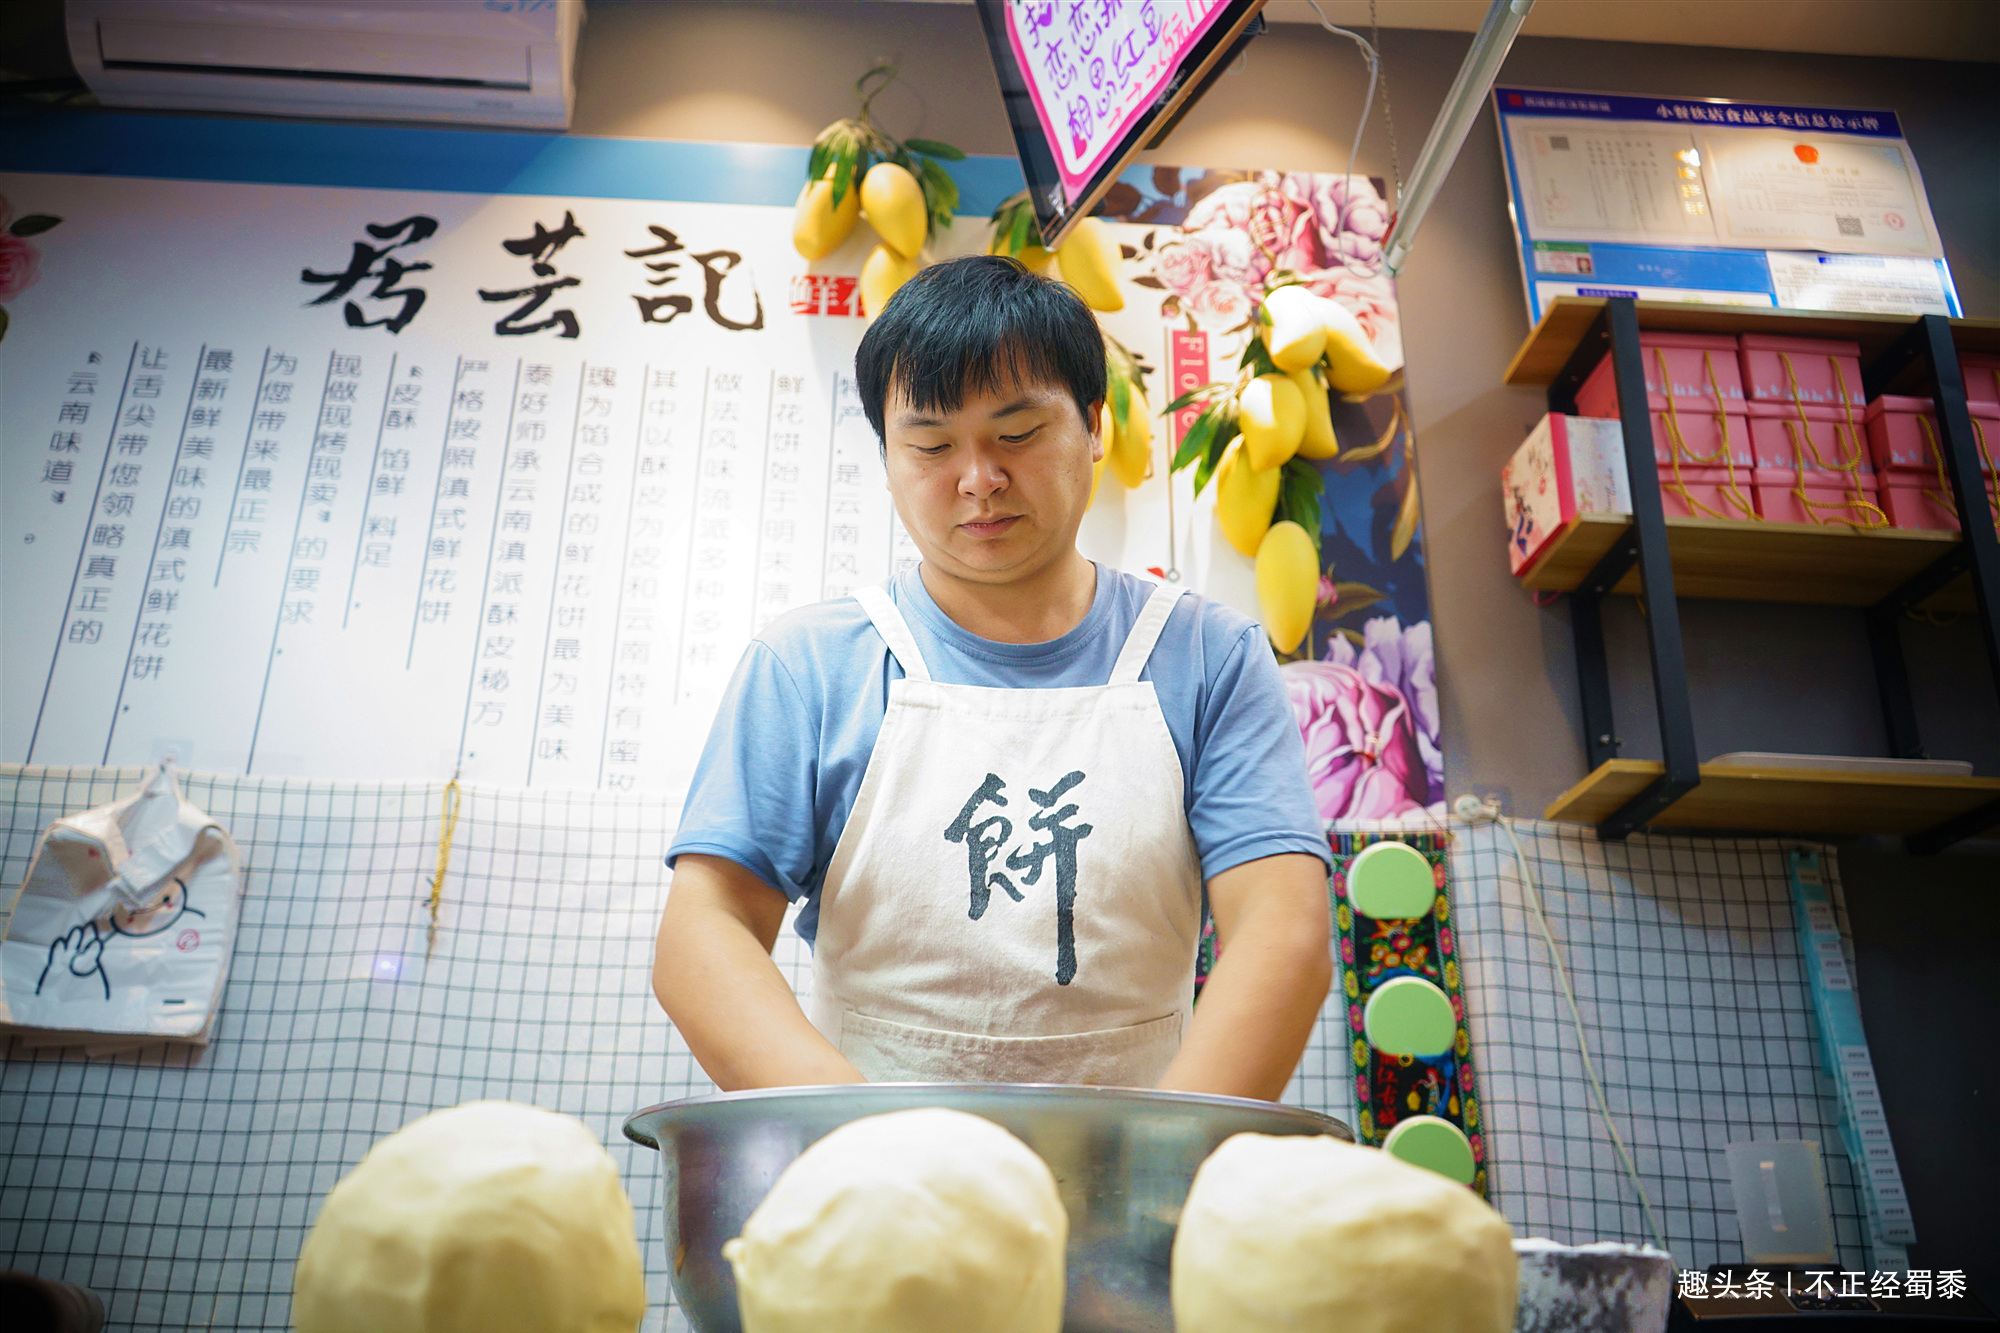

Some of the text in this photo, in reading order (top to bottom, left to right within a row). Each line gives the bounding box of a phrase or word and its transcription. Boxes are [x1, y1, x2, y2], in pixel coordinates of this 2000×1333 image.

[1656, 103, 1880, 132] 小餐饮店食品安全信息公示牌
[68, 346, 169, 645] 让舌尖带您领略真正的
[227, 351, 298, 554] 为您带来最正宗
[420, 360, 490, 624] 严格按照滇式鲜花饼
